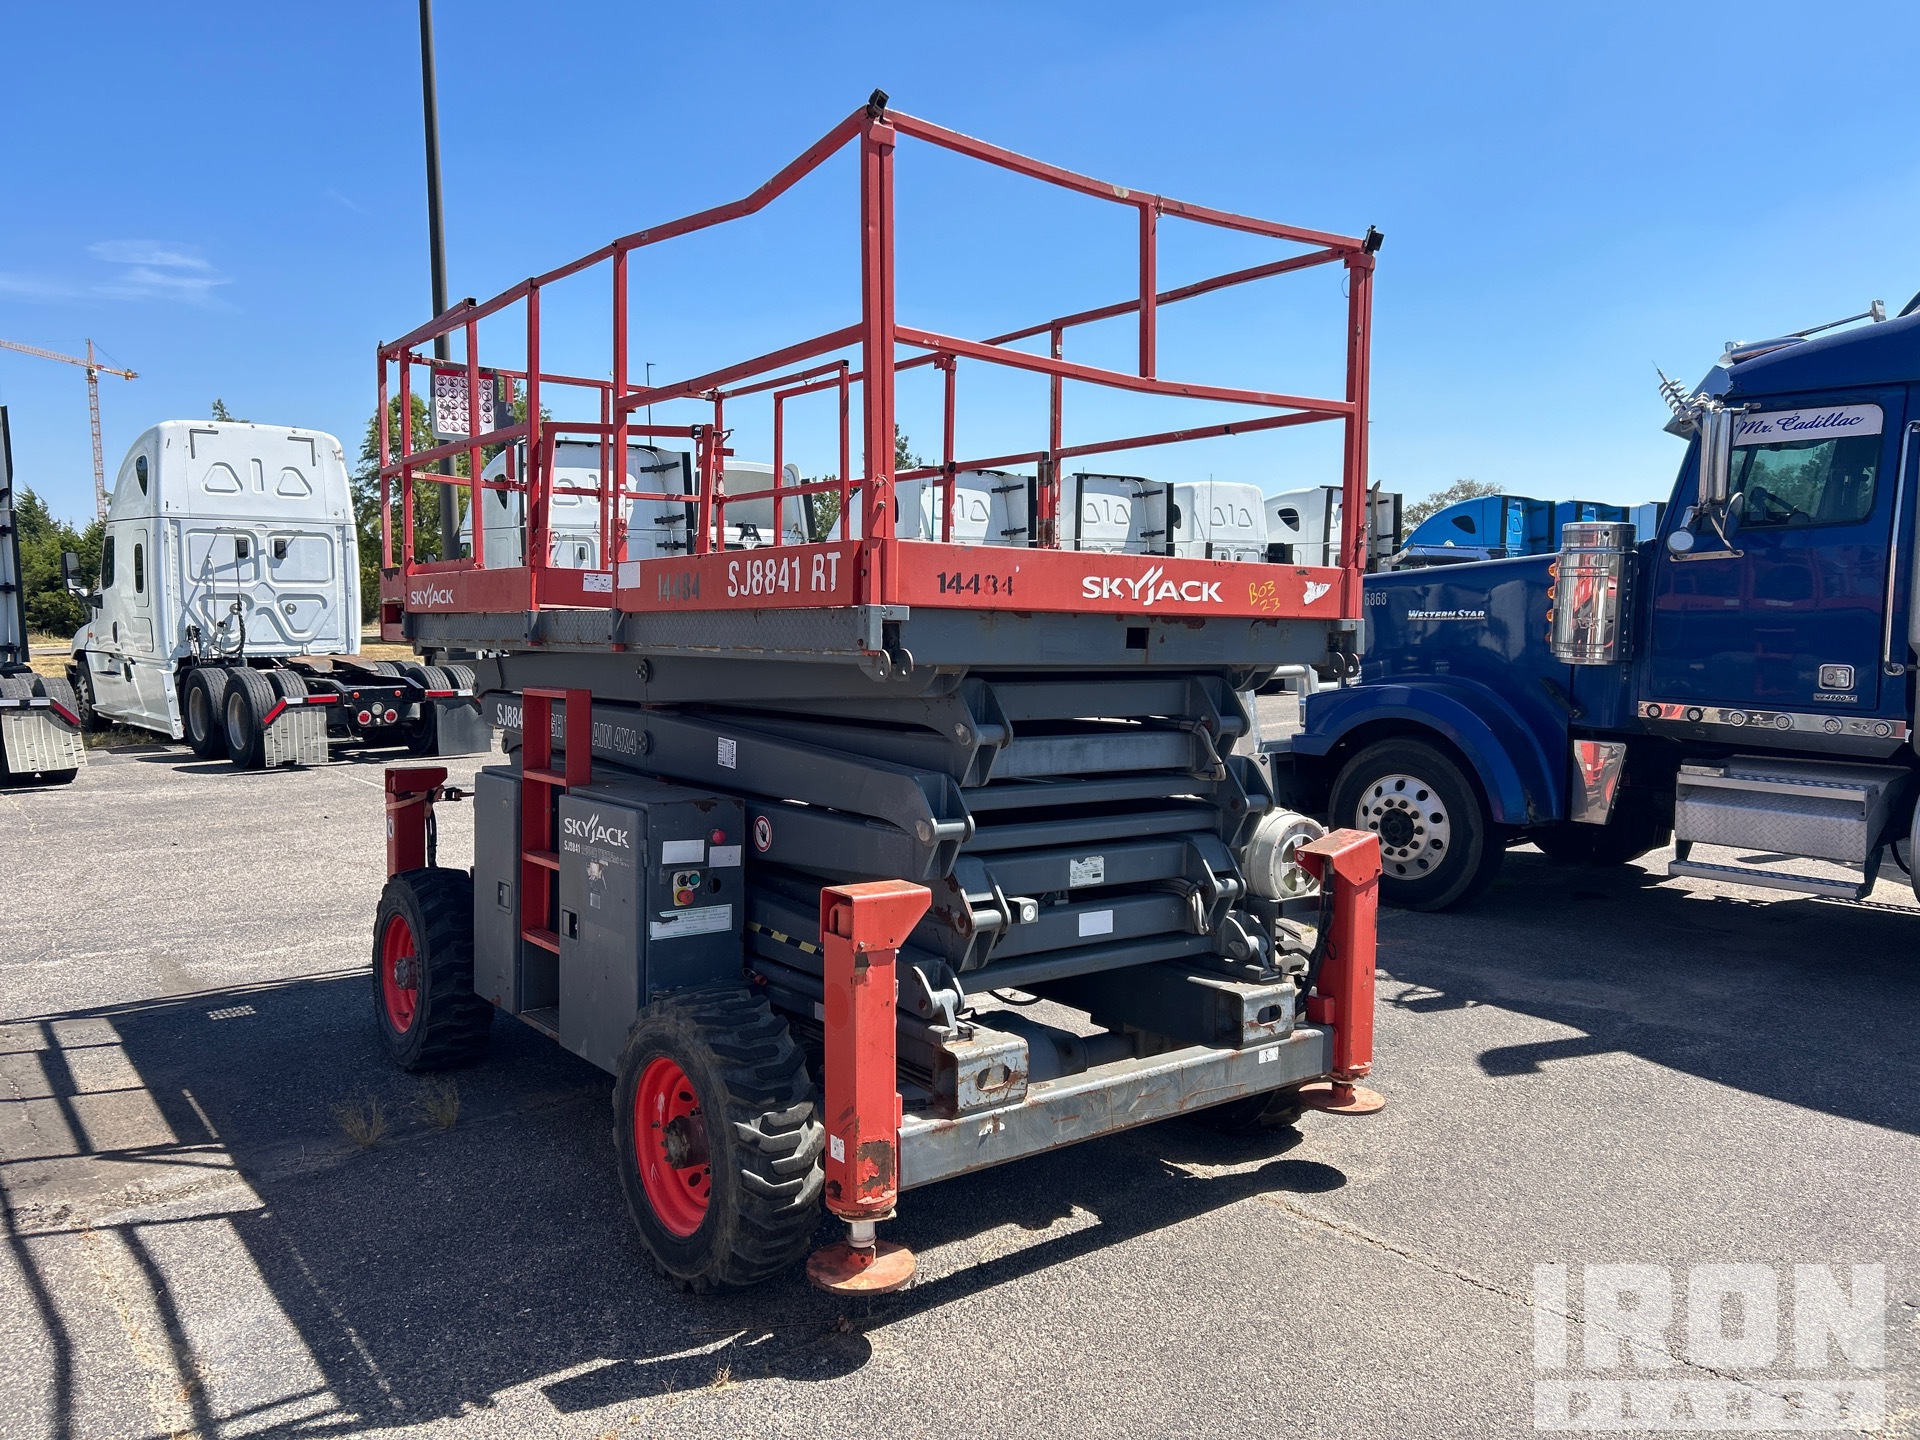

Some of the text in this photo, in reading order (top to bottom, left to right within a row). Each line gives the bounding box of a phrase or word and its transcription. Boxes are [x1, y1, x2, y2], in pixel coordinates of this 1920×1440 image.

[1736, 411, 1865, 435] Mr. Cadillac
[657, 572, 700, 602] 14484
[727, 551, 841, 598] SJ8841 RT
[937, 572, 1013, 596] 14484
[1082, 565, 1223, 606] SKYJACK
[411, 582, 454, 608] SKYJACK
[1260, 598, 1280, 612] 23
[1364, 592, 1387, 606] 6868
[1407, 610, 1486, 620] WESTERN STAR
[497, 703, 523, 729] SJ884
[564, 813, 630, 849] SKYJACK
